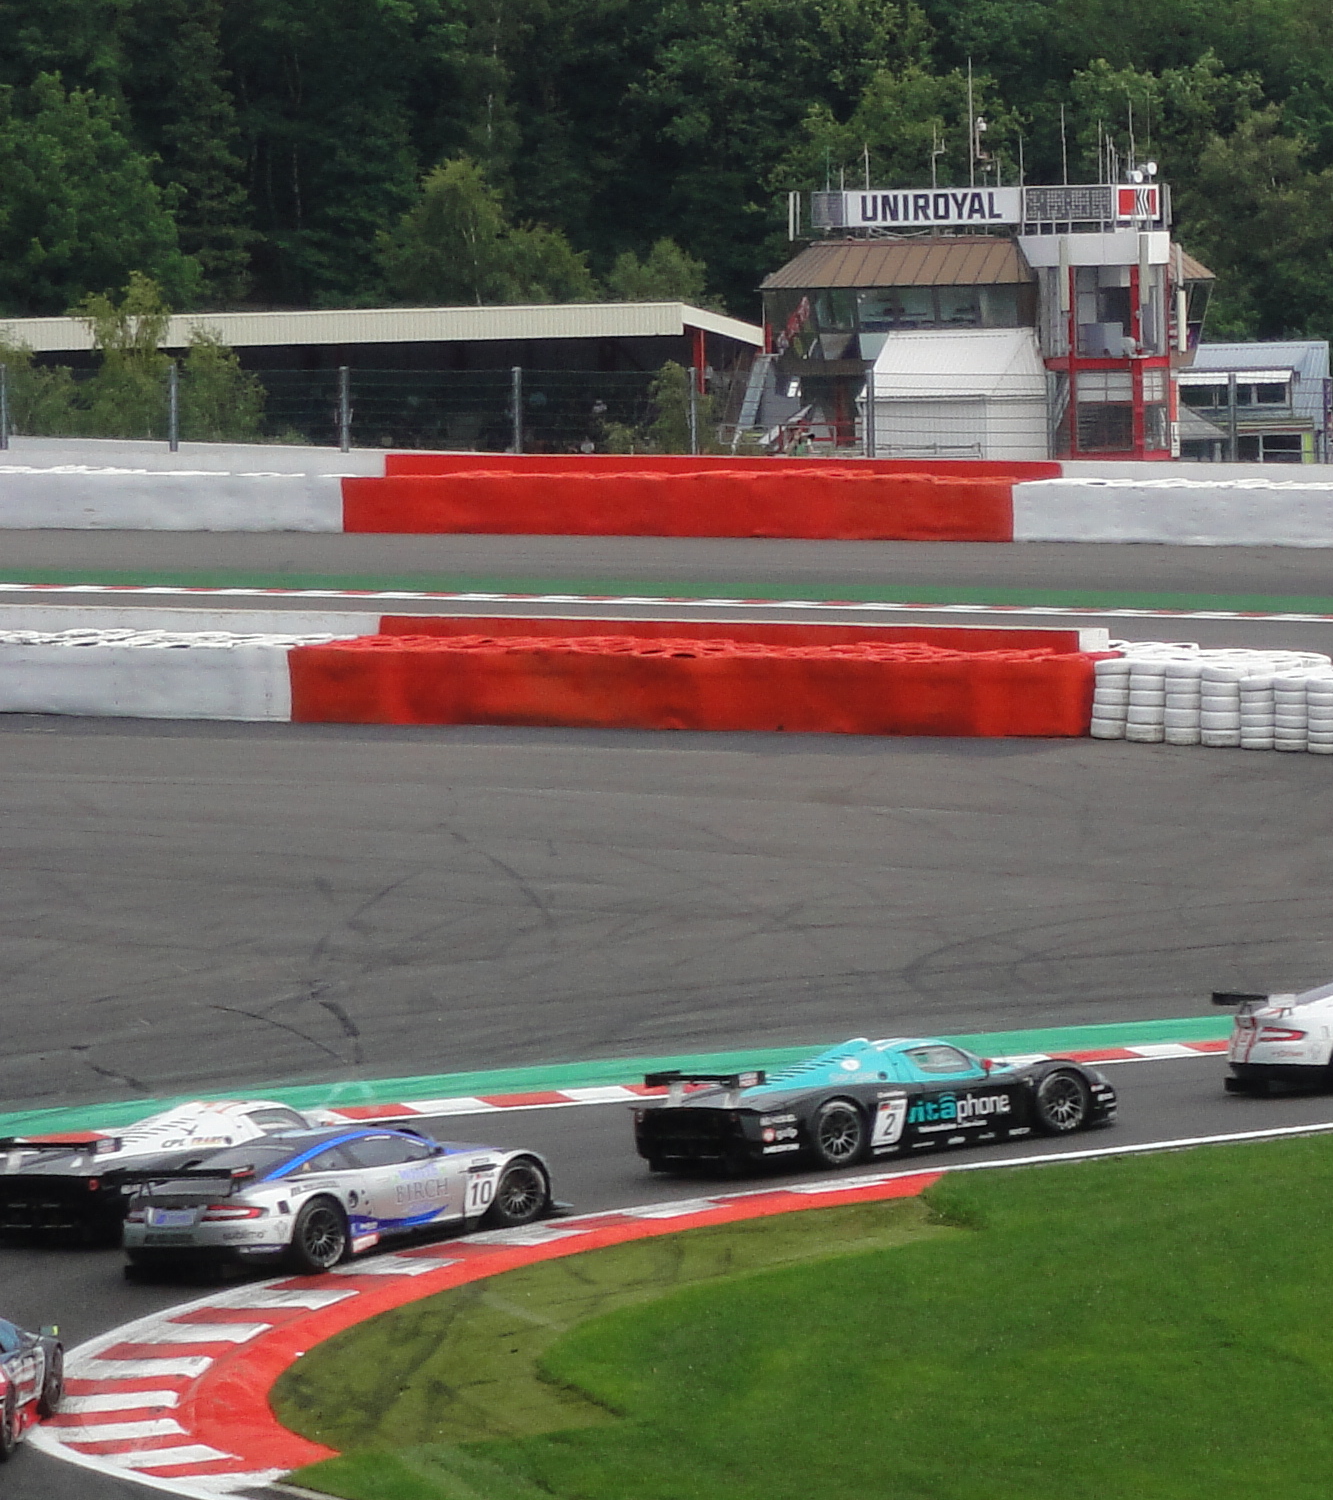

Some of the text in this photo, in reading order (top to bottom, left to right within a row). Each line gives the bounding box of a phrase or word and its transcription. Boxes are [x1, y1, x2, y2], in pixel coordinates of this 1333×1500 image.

[861, 191, 1003, 222] UNIROYAL
[883, 1112, 896, 1137] 2
[395, 1177, 449, 1204] BIRCH
[470, 1180, 493, 1207] 10
